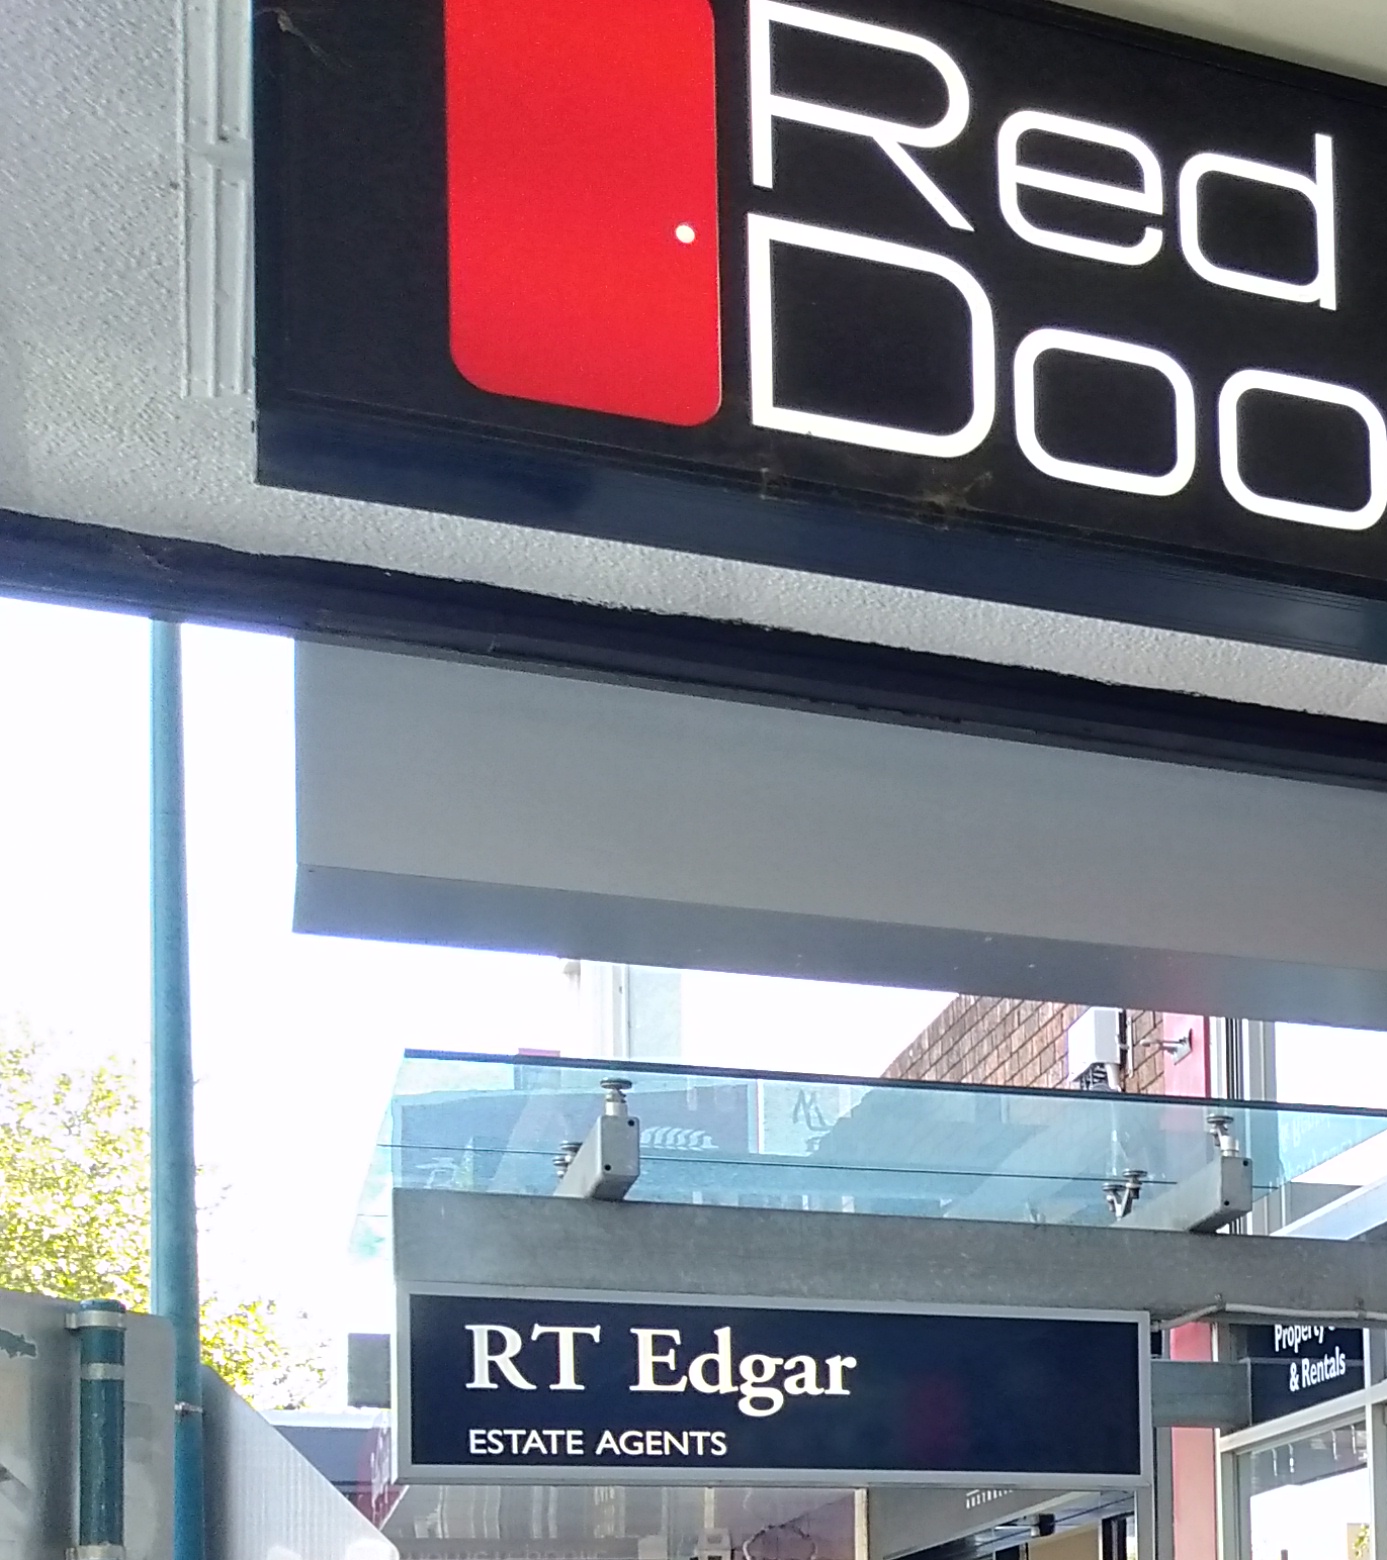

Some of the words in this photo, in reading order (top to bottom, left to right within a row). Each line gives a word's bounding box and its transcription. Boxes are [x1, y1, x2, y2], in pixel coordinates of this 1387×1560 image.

[748, 0, 1337, 311] Red
[465, 1322, 602, 1392] RT
[630, 1326, 858, 1418] Edgar
[1289, 1361, 1300, 1392] &
[1301, 1345, 1346, 1388] Rentals
[468, 1429, 584, 1456] ESTATE
[595, 1430, 728, 1457] AGENTS
